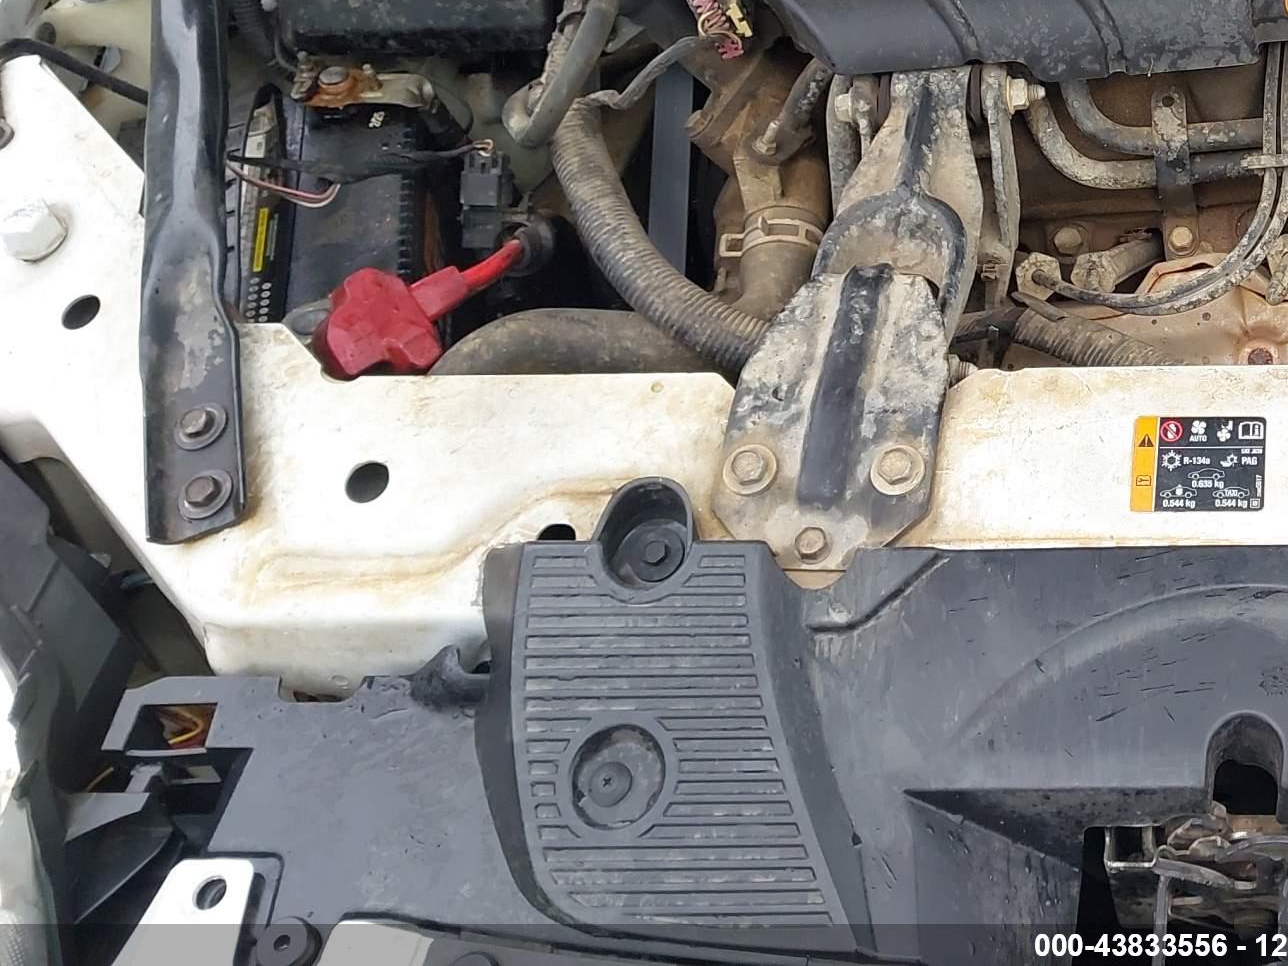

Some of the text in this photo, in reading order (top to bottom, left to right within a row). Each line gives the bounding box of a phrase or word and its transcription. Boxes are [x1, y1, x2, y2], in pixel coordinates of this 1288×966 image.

[1183, 456, 1210, 464] R-134a
[1241, 456, 1258, 465] PAG
[1192, 480, 1224, 489] 0.635 kg
[1224, 489, 1238, 497] TAXI
[1162, 499, 1196, 509] 0.544 kg
[1215, 499, 1237, 507] 0.544
[1238, 499, 1248, 508] kg
